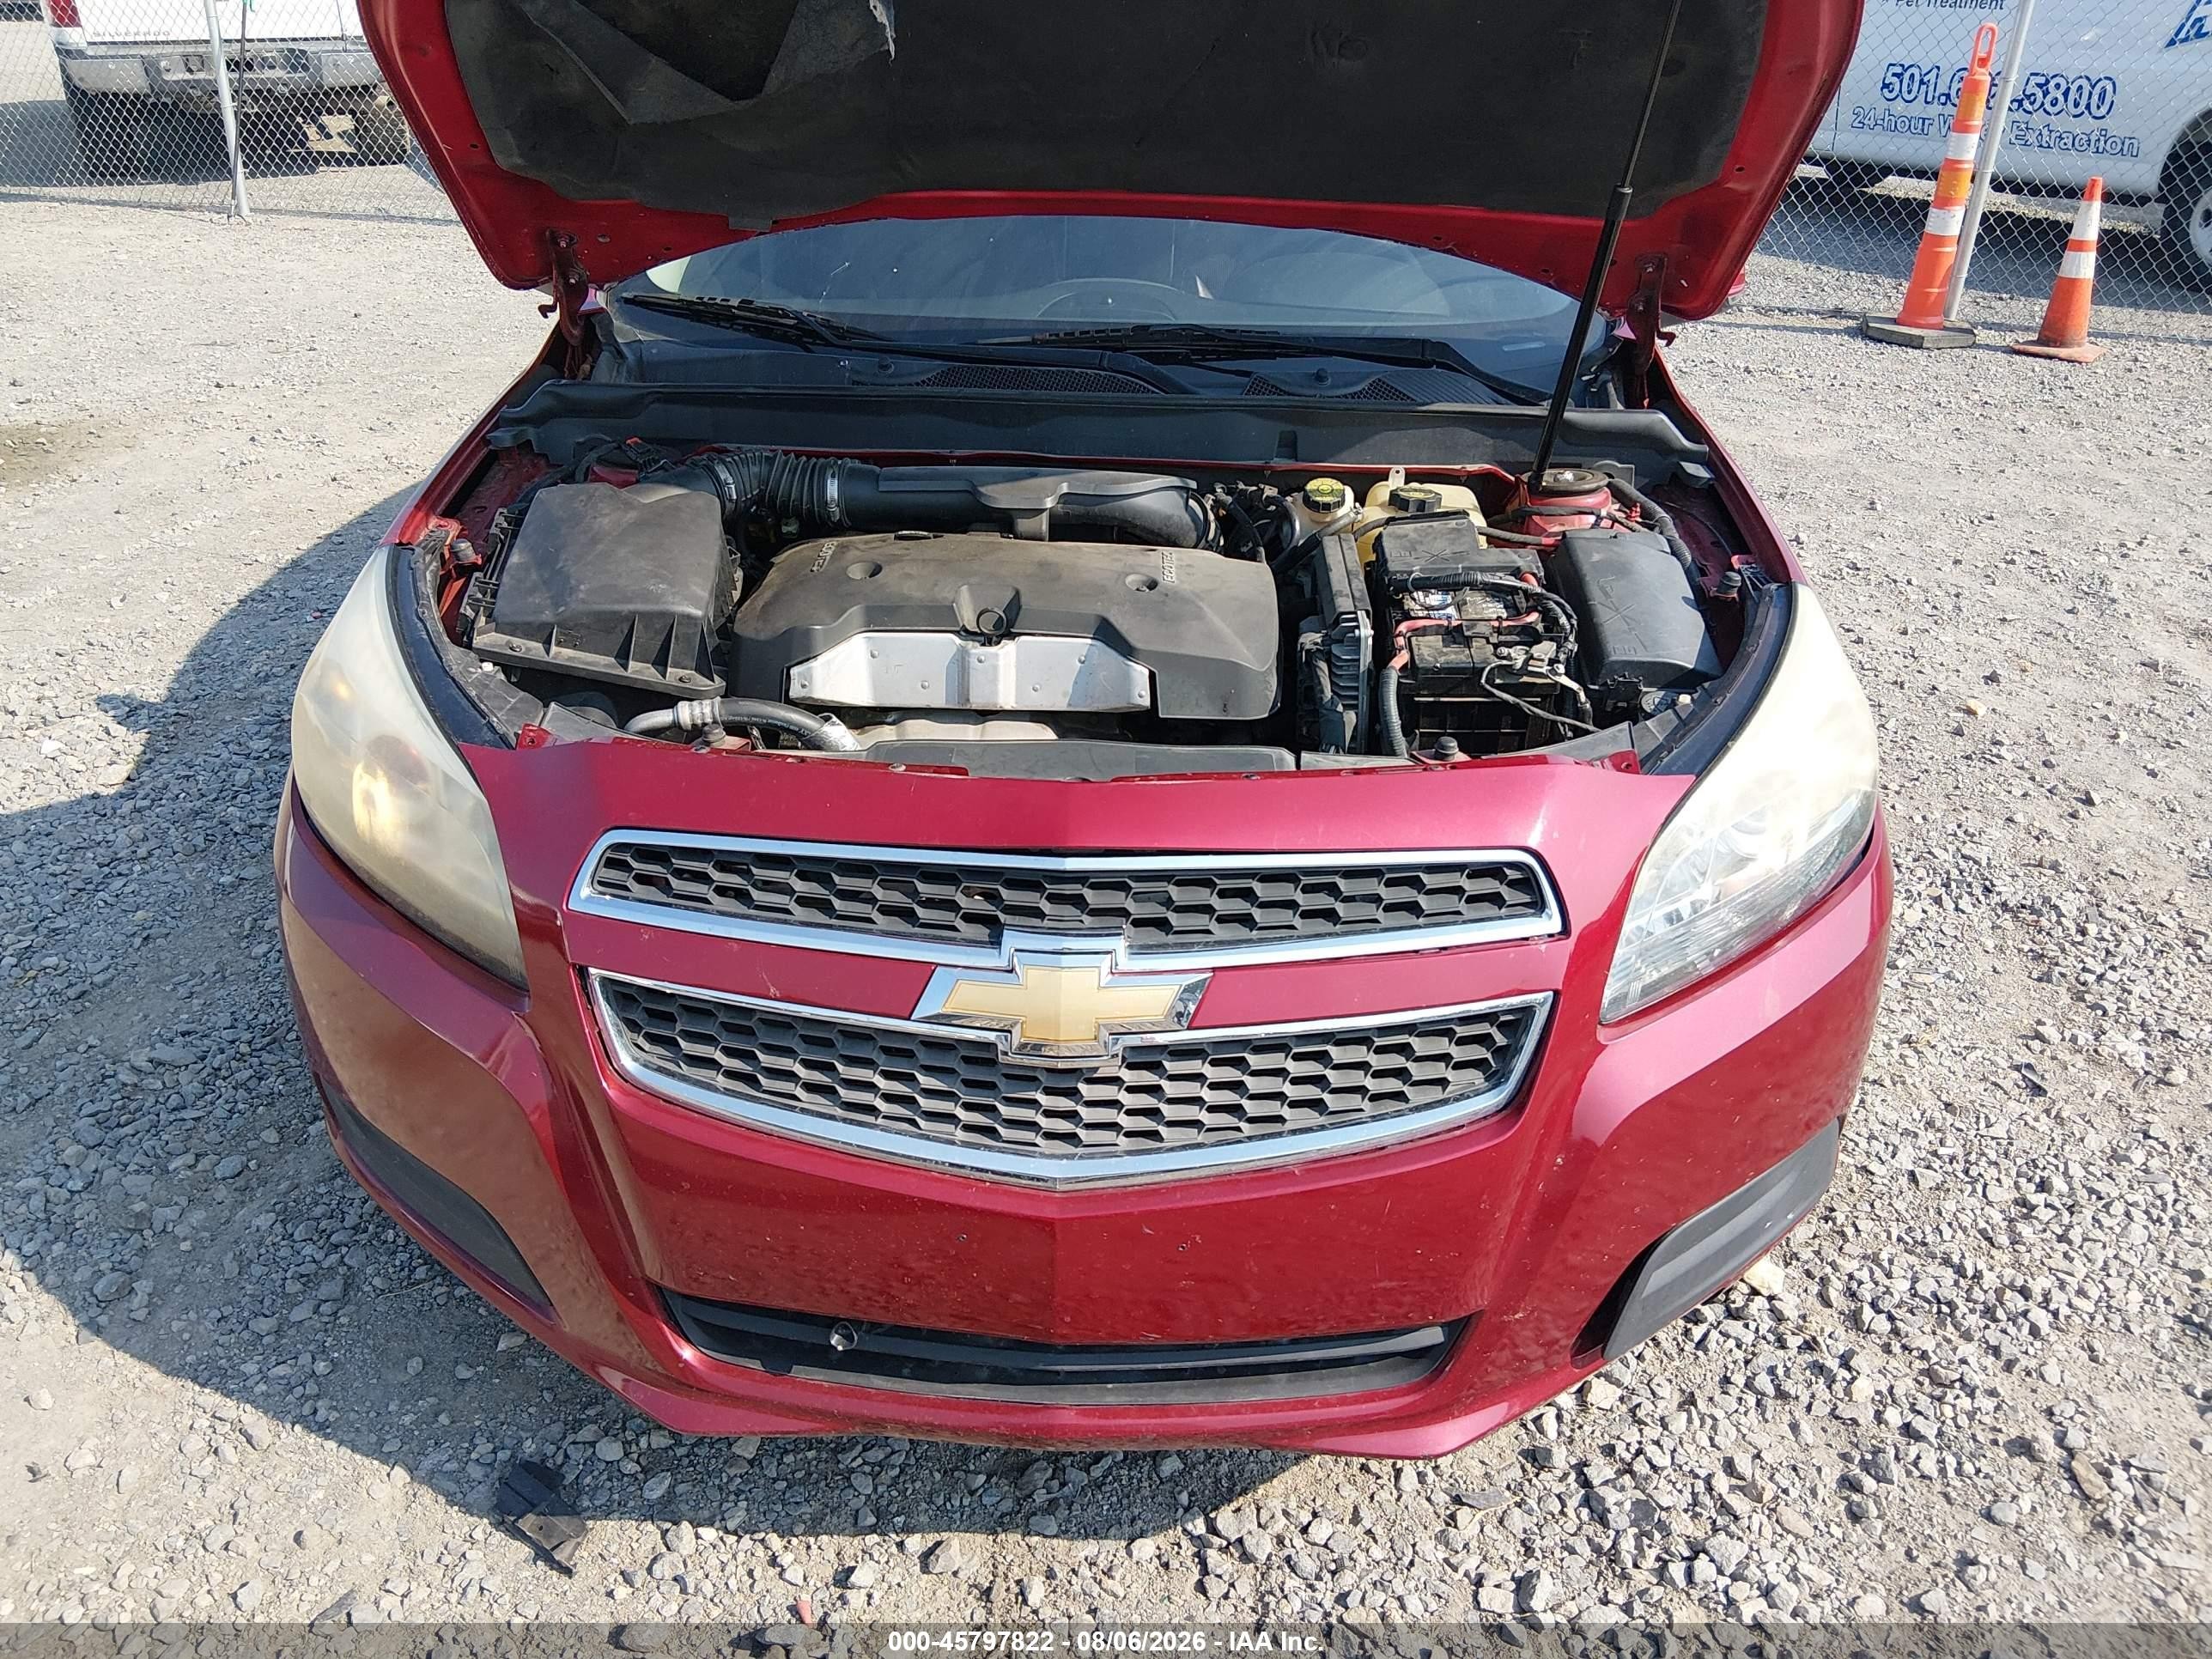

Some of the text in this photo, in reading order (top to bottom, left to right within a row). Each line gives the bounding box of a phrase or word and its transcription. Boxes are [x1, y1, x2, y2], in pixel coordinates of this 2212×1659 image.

[1850, 106, 1933, 136] 24-hour
[2008, 120, 2139, 157] Extraction
[1161, 550, 1176, 584] ECOTEC
